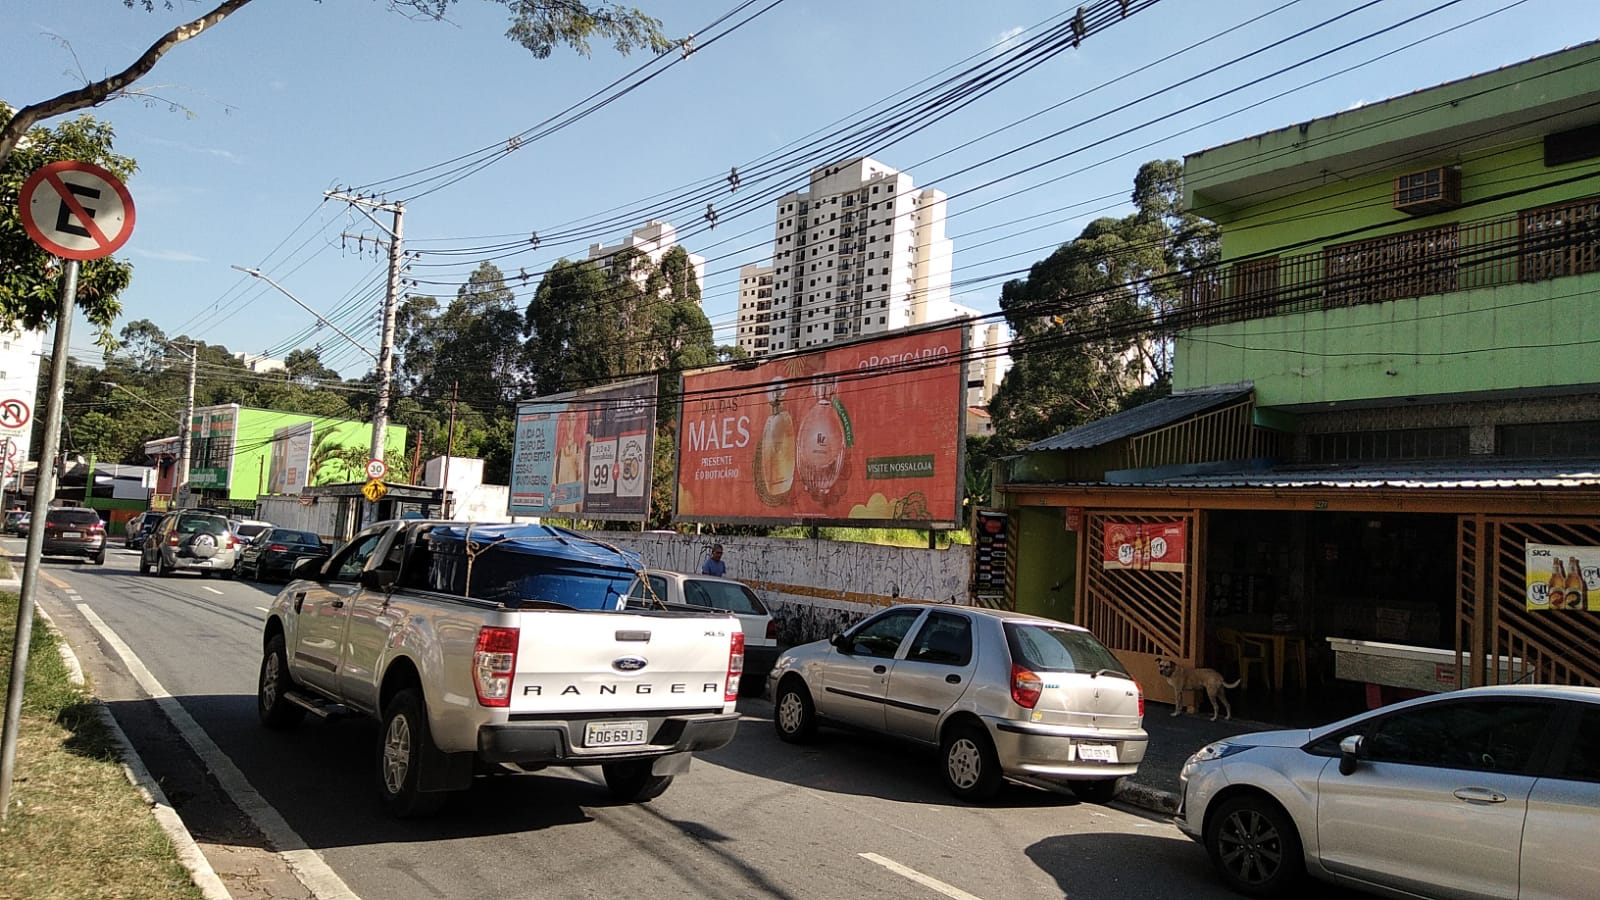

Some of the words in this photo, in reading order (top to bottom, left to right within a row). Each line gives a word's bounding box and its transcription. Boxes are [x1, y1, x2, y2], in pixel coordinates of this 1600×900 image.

[56, 182, 101, 238] E
[701, 400, 716, 415] DIA
[719, 398, 738, 413] DAS
[688, 414, 750, 452] MÃES
[701, 455, 733, 467] PRESENTE
[867, 463, 888, 473] VISITE
[889, 462, 912, 472] NOSSA
[913, 461, 932, 471] LOJA
[370, 464, 382, 473] 30
[523, 683, 718, 696] RANGER
